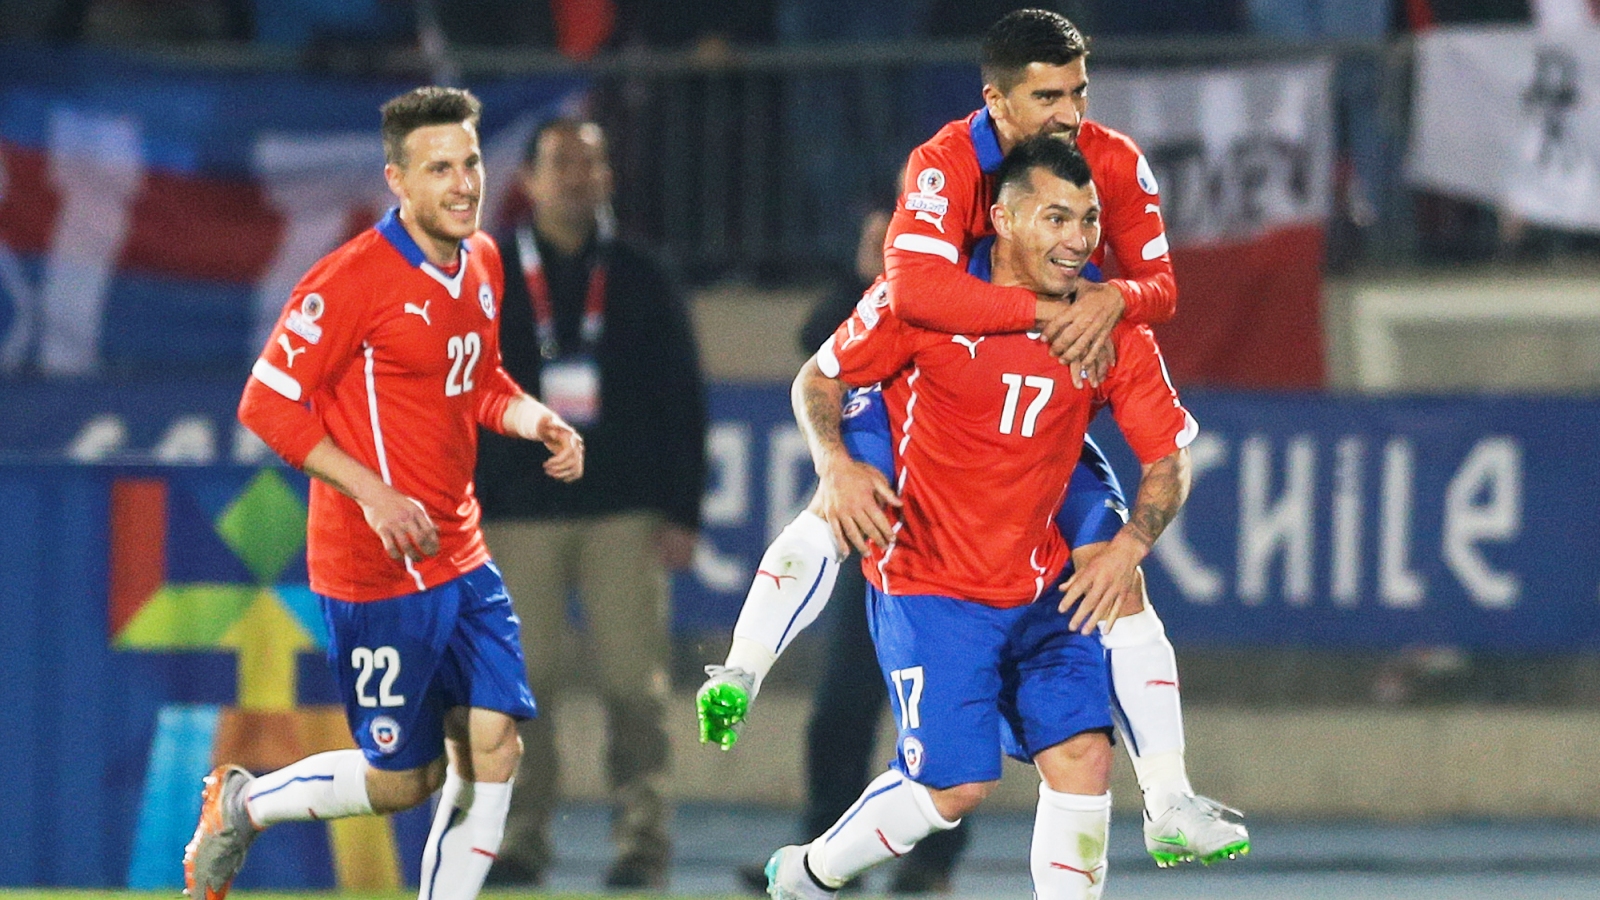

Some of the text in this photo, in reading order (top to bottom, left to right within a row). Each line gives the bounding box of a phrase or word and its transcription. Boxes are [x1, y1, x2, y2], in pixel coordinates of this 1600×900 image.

[444, 331, 481, 398] 22
[998, 372, 1055, 438] 17
[350, 645, 406, 708] 22
[890, 665, 924, 731] 17
